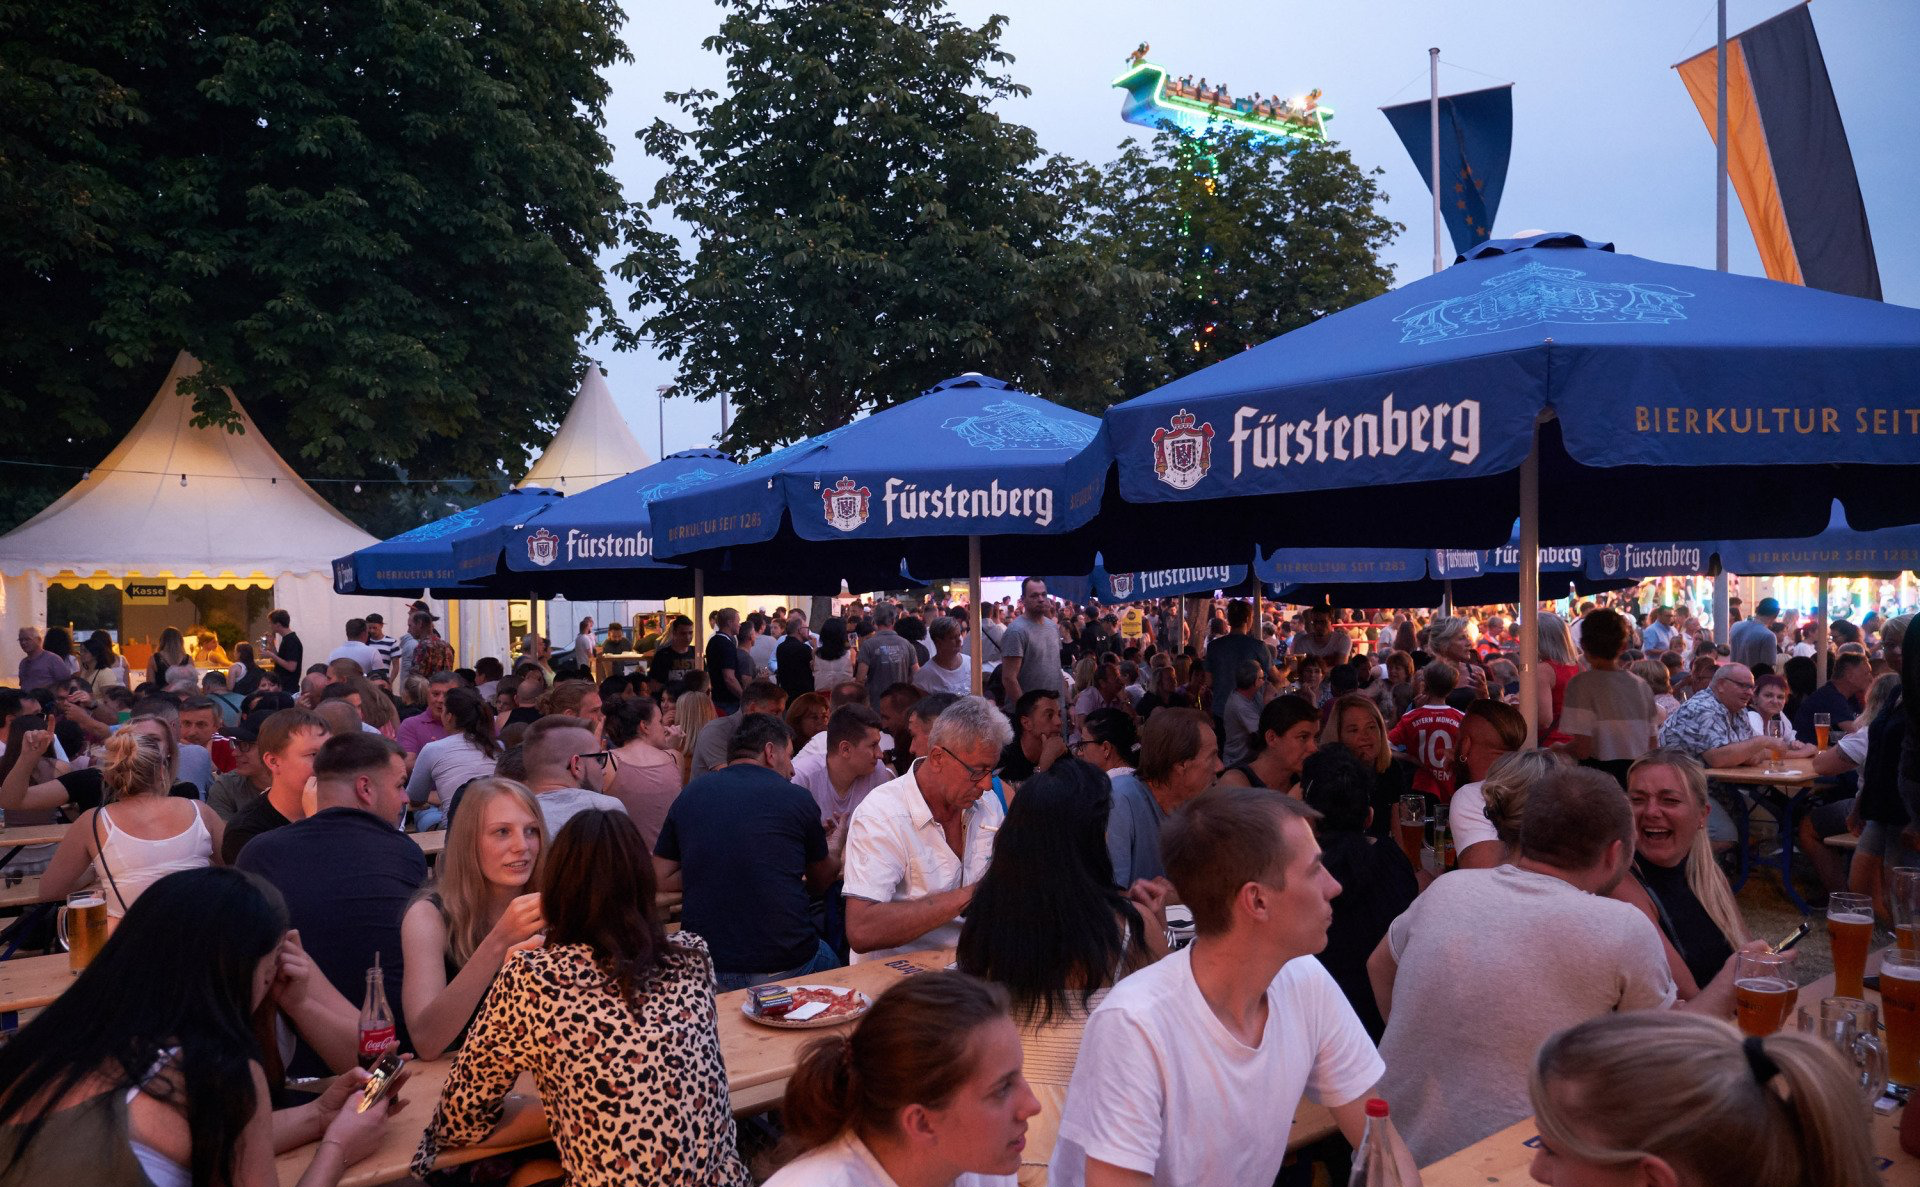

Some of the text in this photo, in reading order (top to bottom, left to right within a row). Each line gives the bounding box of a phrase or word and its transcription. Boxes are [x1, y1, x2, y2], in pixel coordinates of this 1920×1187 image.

[1635, 405, 1920, 435] BIERKULTUR SEIT
[132, 586, 164, 596] Kasse
[1418, 729, 1453, 768] 10
